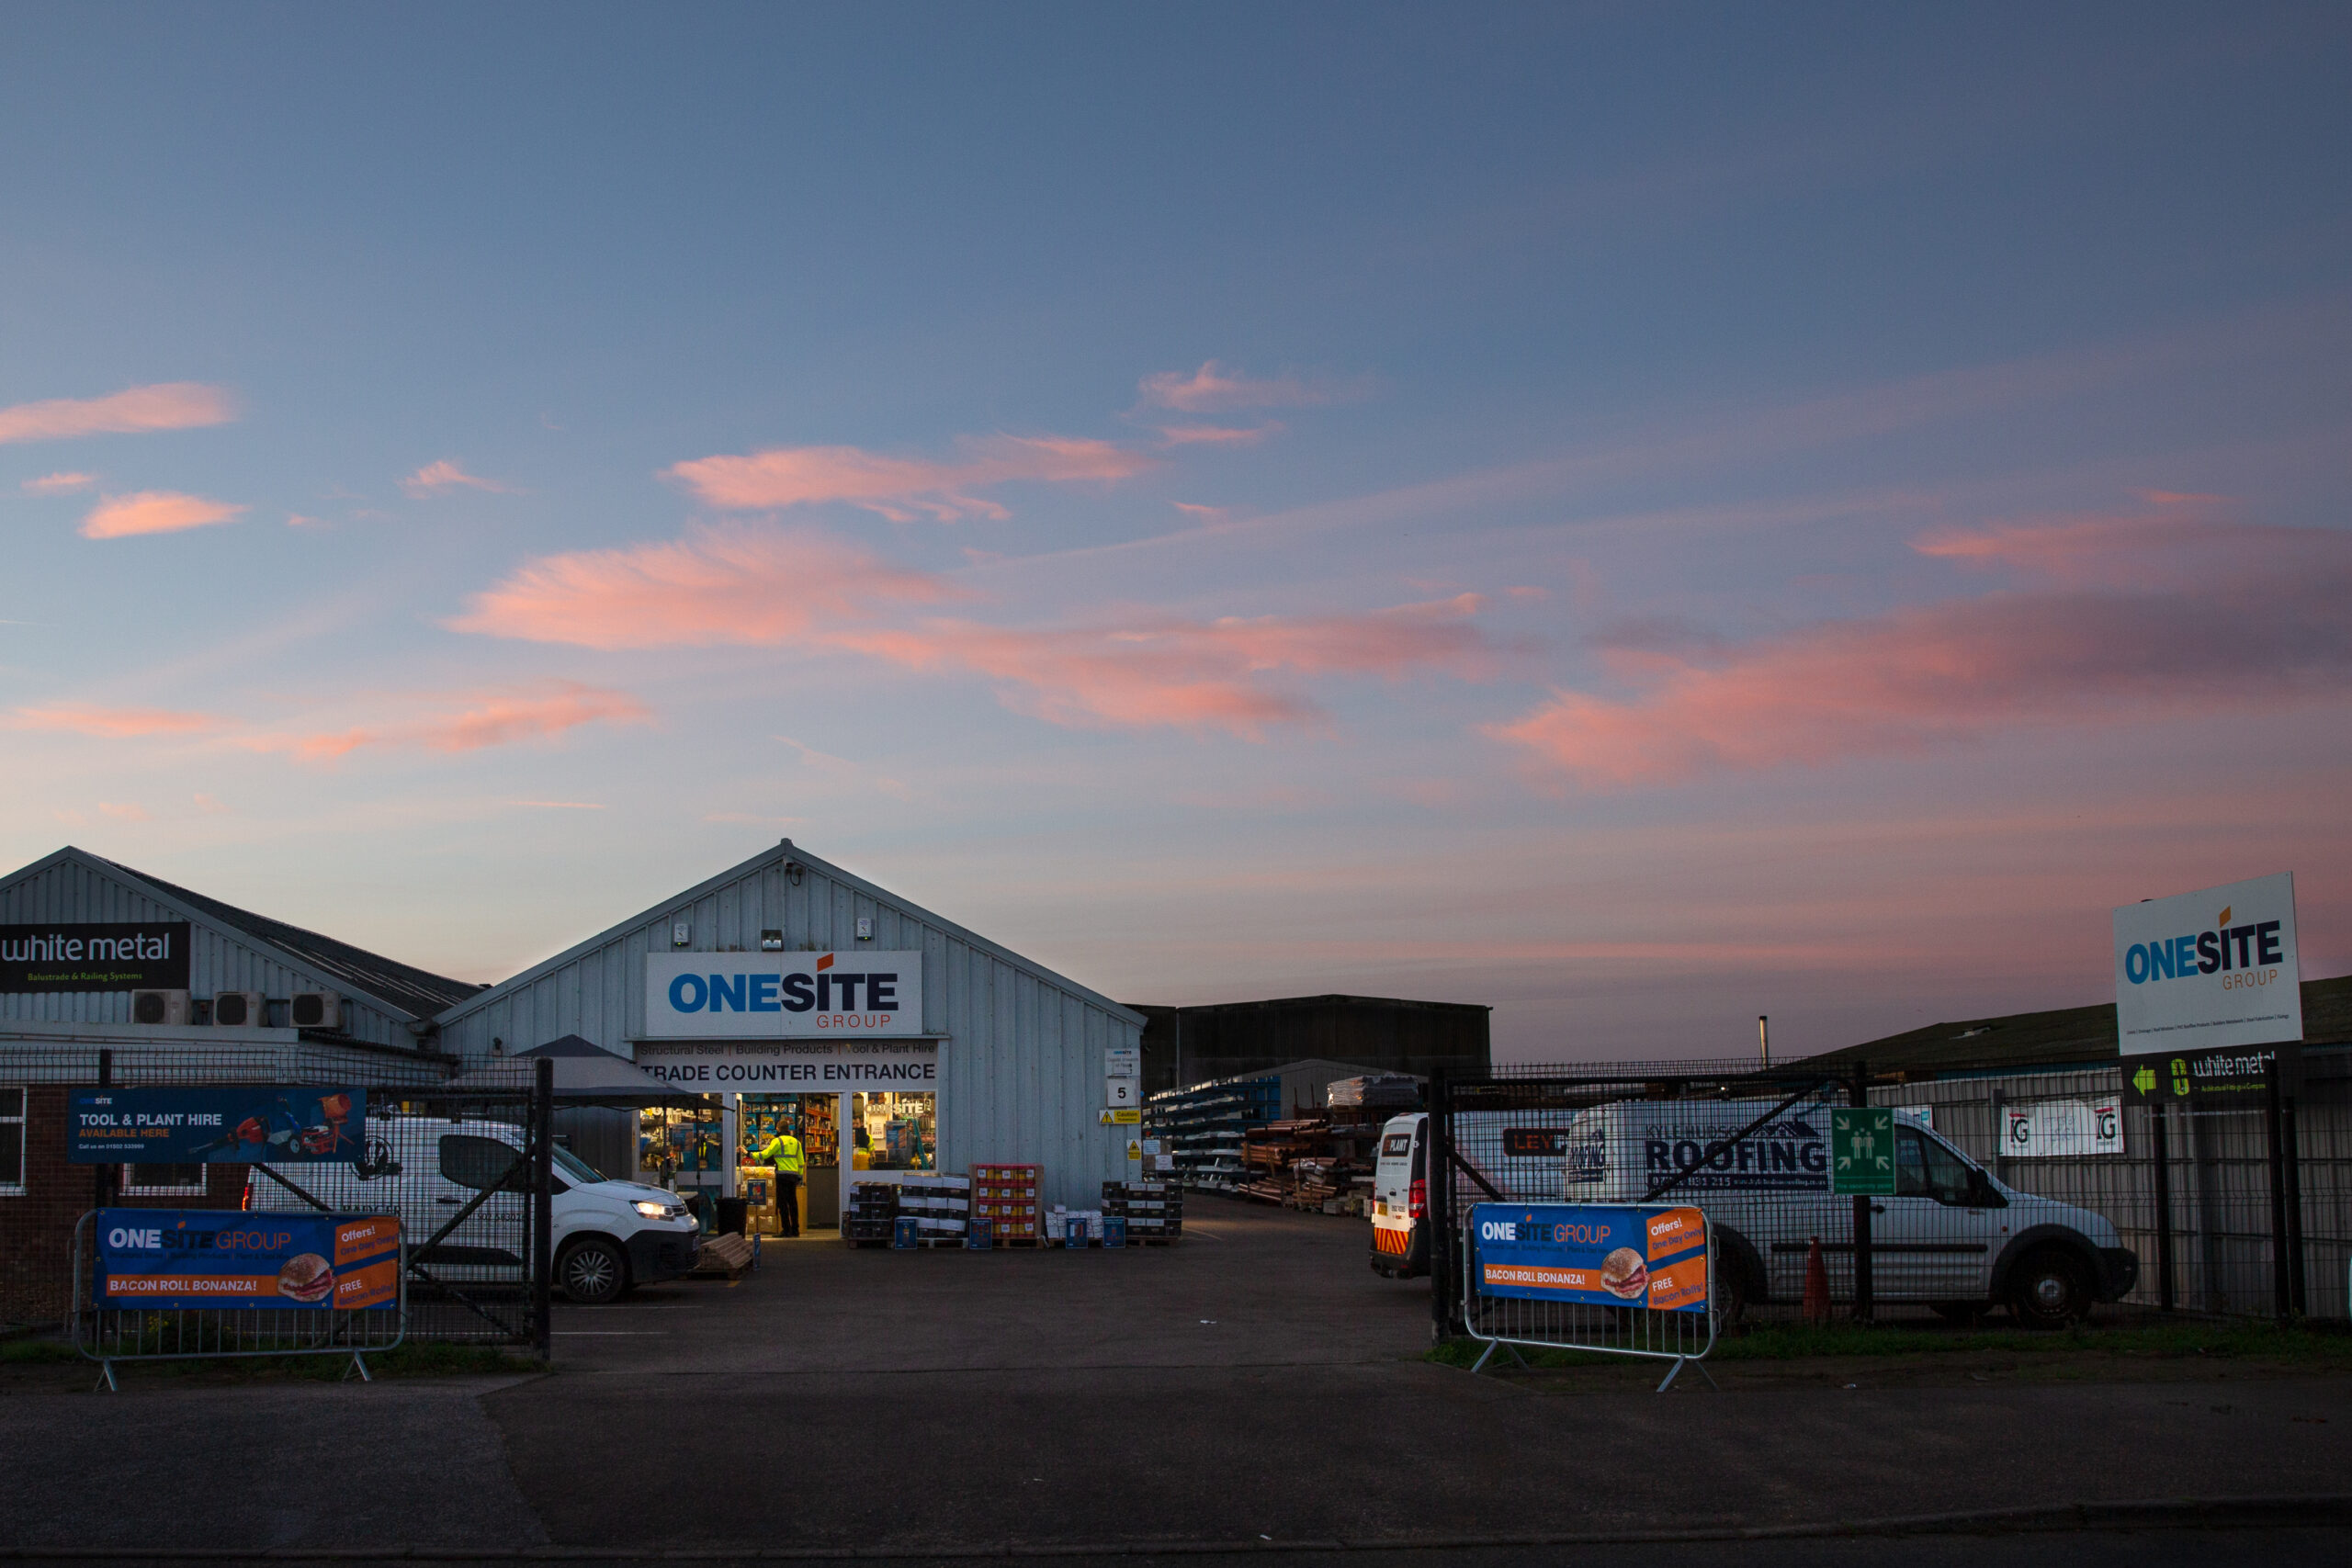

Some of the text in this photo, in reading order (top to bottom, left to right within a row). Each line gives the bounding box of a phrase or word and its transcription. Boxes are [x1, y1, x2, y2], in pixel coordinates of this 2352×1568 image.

[1, 932, 170, 962] white metal
[2125, 906, 2283, 985] ONESITE
[28, 973, 69, 981] Balustrade
[81, 972, 107, 982] Railing
[110, 972, 142, 980] Systems
[669, 953, 899, 1012] ONESITE
[2222, 969, 2278, 990] GROUP
[817, 1015, 891, 1028] GROUP
[640, 1044, 694, 1055] Structural
[696, 1043, 724, 1055] Steel
[736, 1043, 780, 1056] Building
[784, 1043, 832, 1055] Products
[872, 1043, 879, 1054] &
[882, 1043, 909, 1054] Plant
[912, 1043, 934, 1054] Hire
[640, 1064, 935, 1080] TRADE COUNTER ENTRANCE
[2192, 1051, 2276, 1077] white met
[1117, 1087, 1126, 1099] 5
[80, 1113, 222, 1125] TOOL & PLANT HIRE
[79, 1128, 170, 1138] AVAILABLE HERE
[1684, 1125, 1749, 1138] HUDSO
[1514, 1134, 1568, 1150] LEYP
[1645, 1140, 1827, 1172] ROOFING
[341, 1224, 376, 1242] Offers!
[1482, 1213, 1611, 1244] ONESITE GROUP
[1651, 1217, 1682, 1235] Offers!
[108, 1221, 292, 1249] ONESITE GROUP
[1652, 1240, 1668, 1250] One
[1668, 1234, 1683, 1246] Day
[1485, 1268, 1586, 1285] BACON ROLL BONANZA!
[1652, 1277, 1674, 1292] FREE
[109, 1280, 257, 1291] BACON ROLL BONANZA!
[339, 1282, 395, 1305] Bacon Rolls!
[340, 1279, 363, 1293] FREE
[1654, 1281, 1703, 1305] Bacon Rolls!
